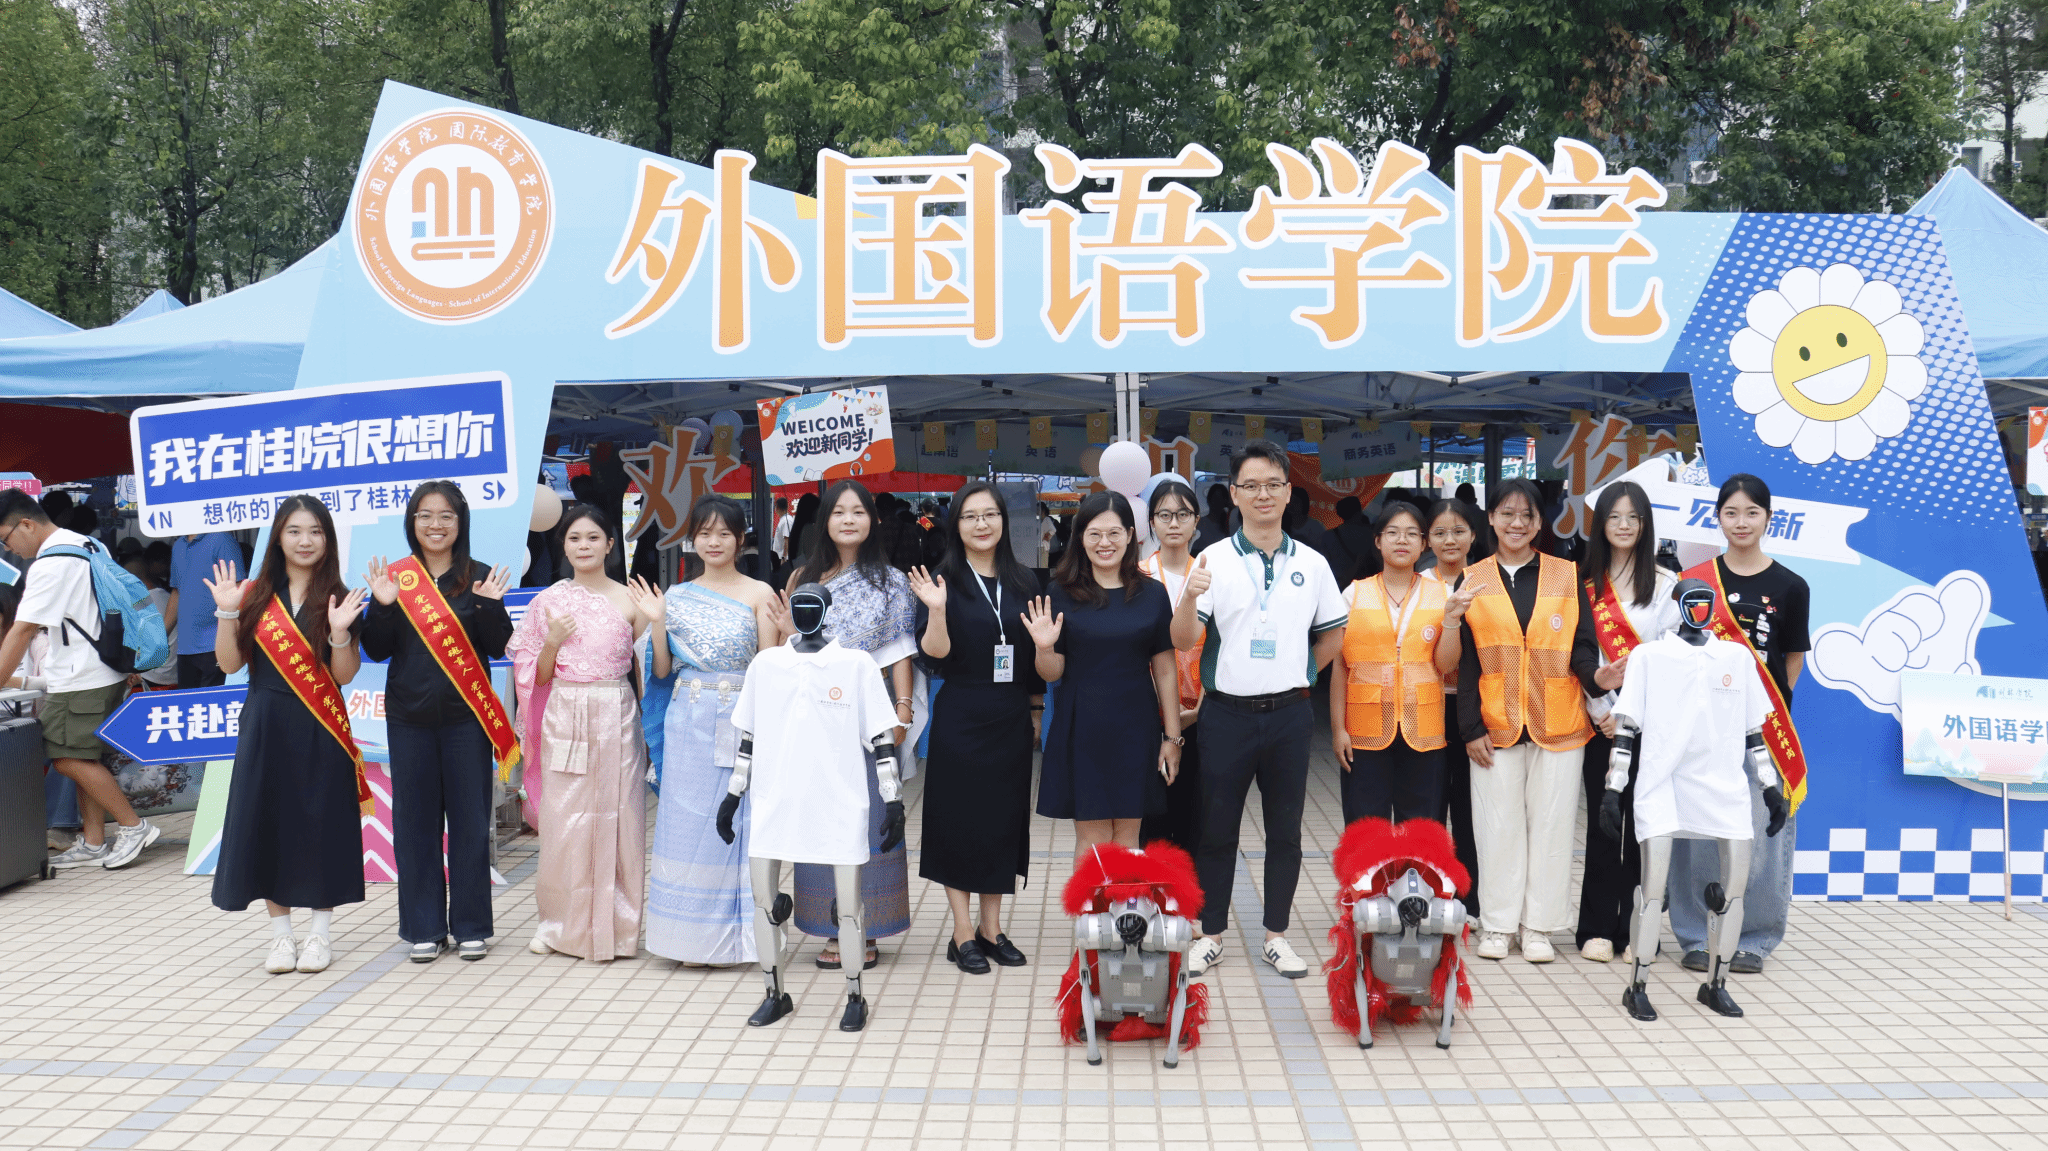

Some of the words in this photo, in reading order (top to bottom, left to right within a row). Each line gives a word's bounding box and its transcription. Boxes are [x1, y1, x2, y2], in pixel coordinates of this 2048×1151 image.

[604, 137, 1669, 354] 外国语学院
[370, 236, 383, 261] School
[380, 262, 388, 270] of
[385, 268, 406, 292] Foreign
[406, 288, 443, 308] Languages
[448, 298, 472, 308] School
[473, 294, 481, 303] of
[481, 264, 521, 300] International
[517, 229, 537, 266] Education
[148, 410, 495, 487] 我在桂院很想你
[1343, 442, 1397, 461] 商务英语
[0, 480, 33, 492] 同学!!
[482, 481, 495, 501] S
[159, 511, 173, 529] N
[1650, 498, 1806, 541] 一见新
[1943, 714, 2048, 744] 外国语学
